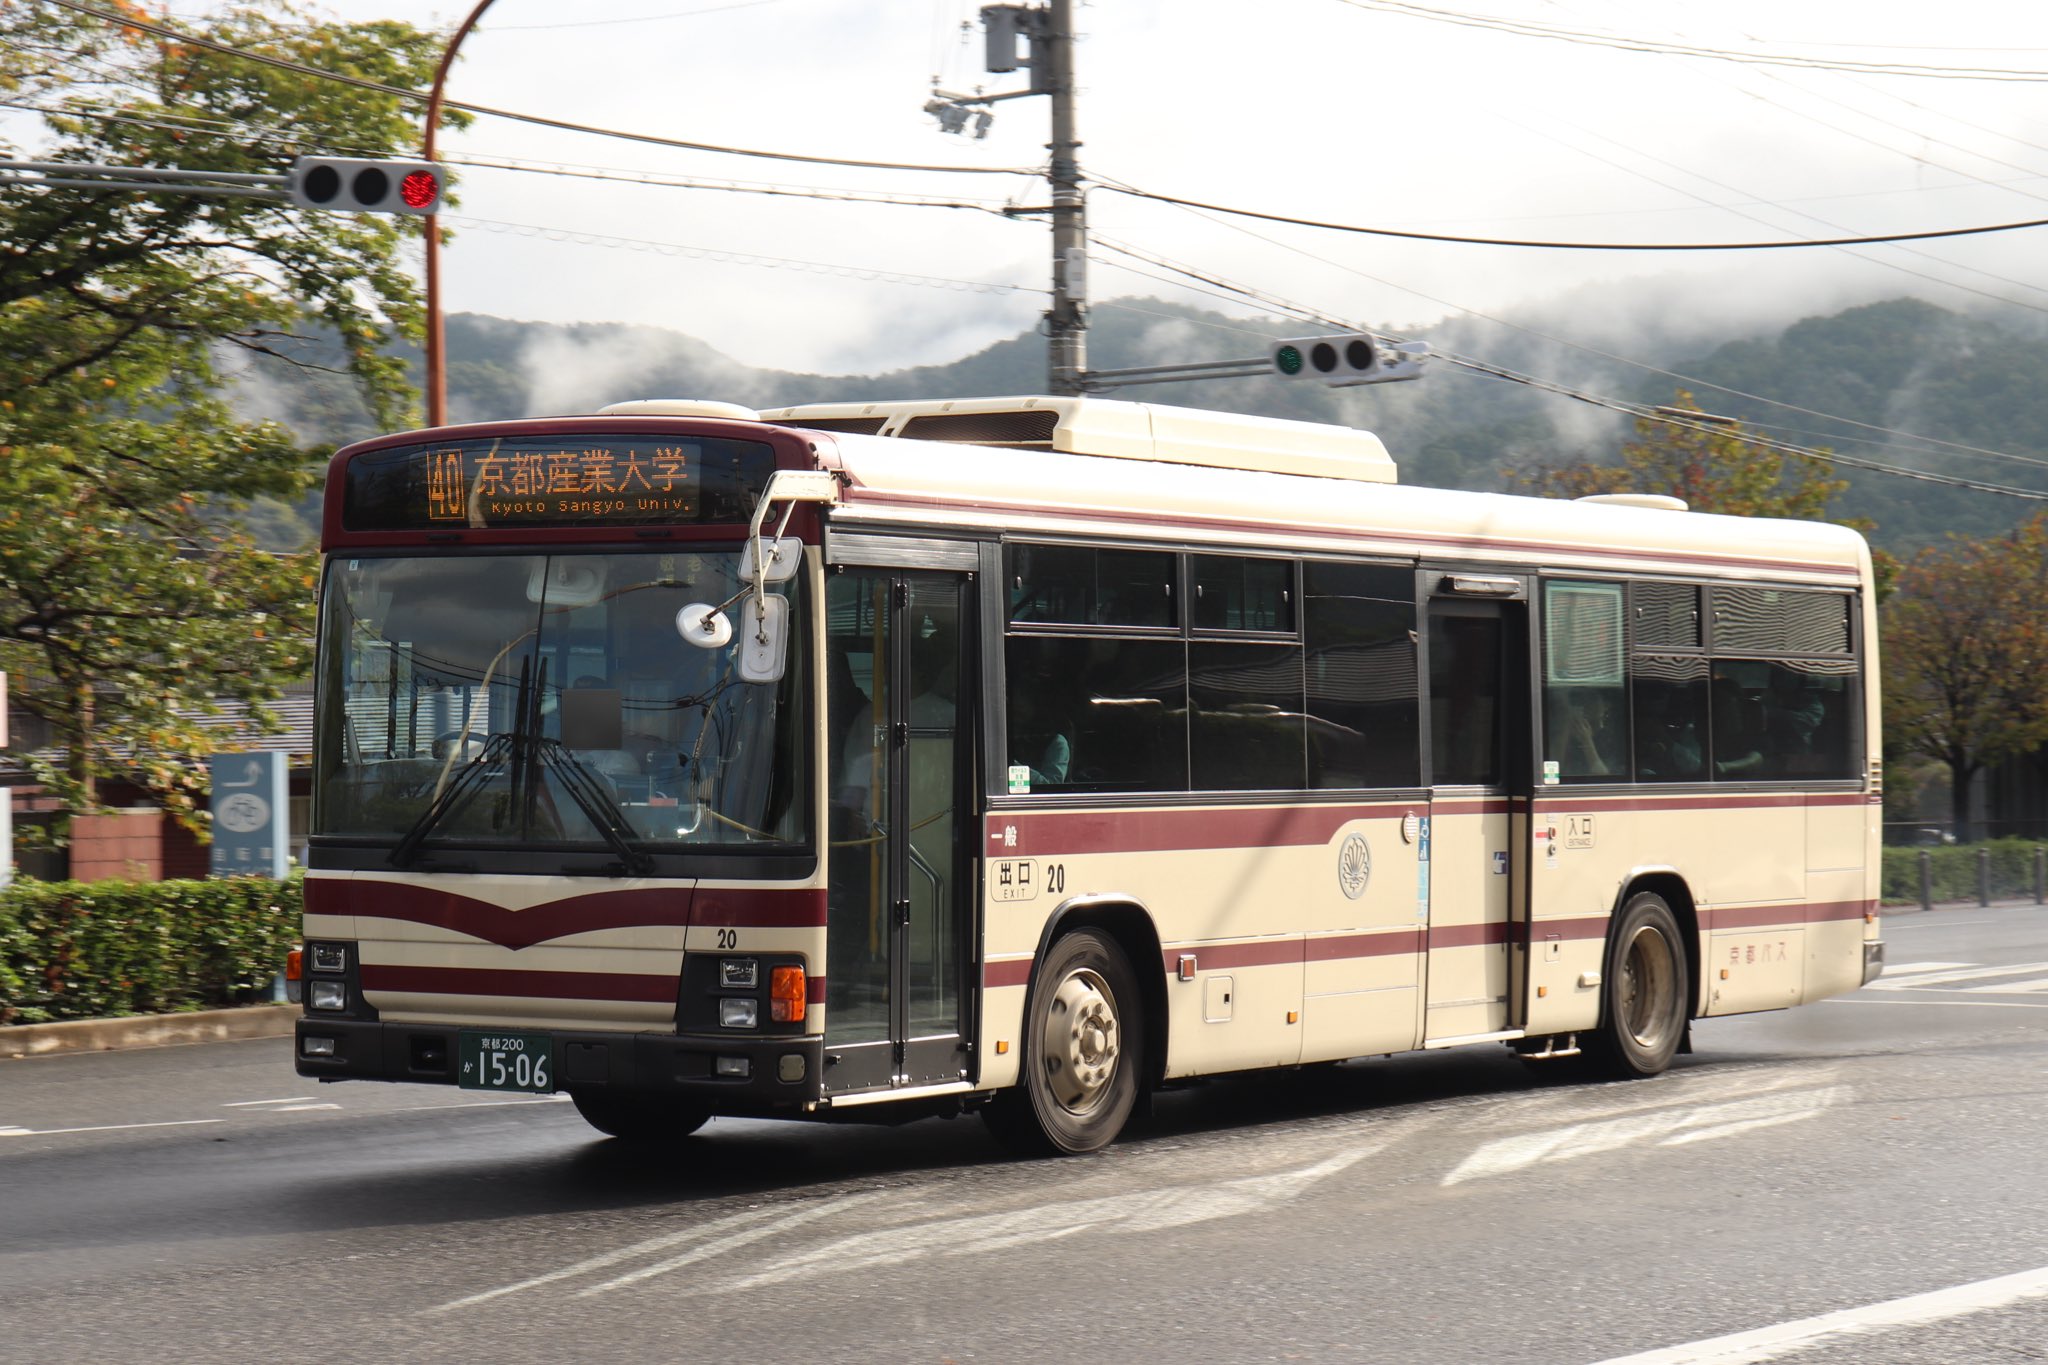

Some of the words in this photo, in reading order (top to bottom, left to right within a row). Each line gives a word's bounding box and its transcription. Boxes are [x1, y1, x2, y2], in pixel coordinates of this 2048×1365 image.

[474, 447, 688, 495] 京都産業大学
[491, 500, 546, 517] Kyoto
[559, 499, 625, 515] Sangyo
[638, 498, 690, 513] Univ.
[990, 825, 1017, 847] 一般
[1568, 818, 1592, 836] 入口
[1000, 862, 1030, 886] 出口
[1047, 864, 1065, 894] 20
[1004, 888, 1026, 899] EXIT
[717, 928, 737, 950] 20
[463, 1061, 474, 1074] か
[479, 1051, 548, 1088] 15-06
